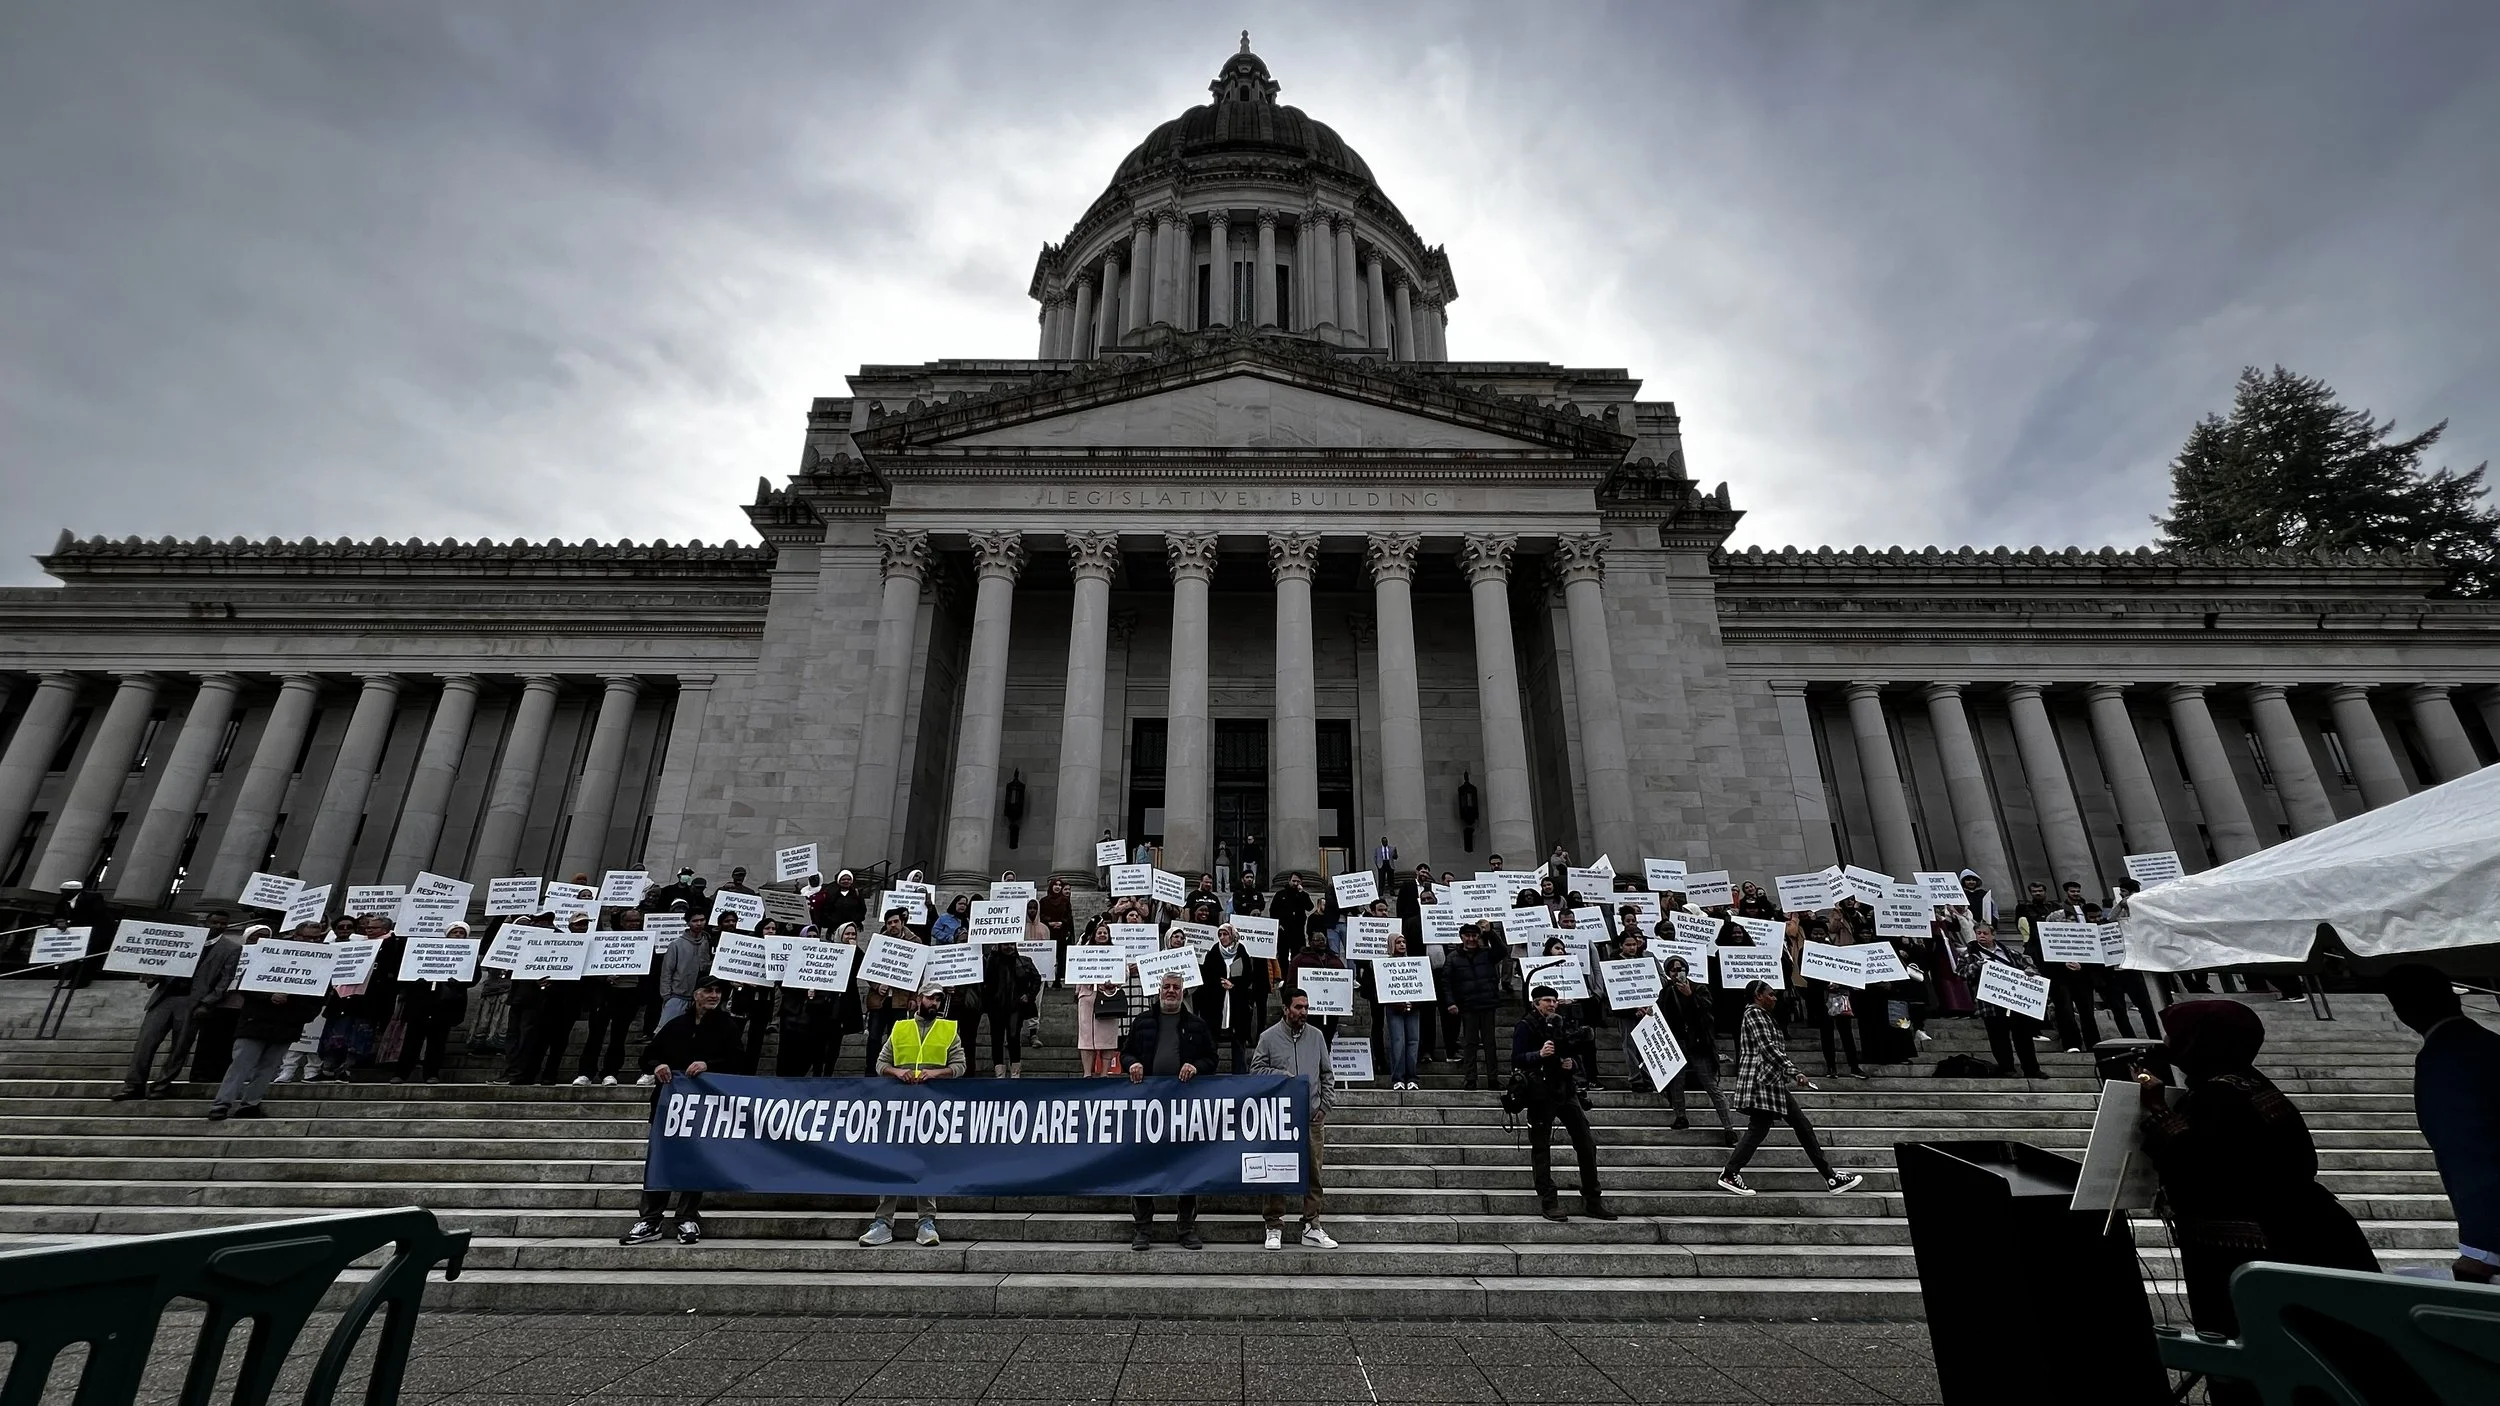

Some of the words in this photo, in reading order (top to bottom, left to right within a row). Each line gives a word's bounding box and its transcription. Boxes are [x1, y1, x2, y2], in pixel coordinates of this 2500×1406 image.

[1048, 490, 1248, 507] LEGISLATIVE
[1291, 490, 1440, 506] BUILDING
[726, 896, 758, 905] REFUGEES
[975, 917, 1009, 925] RESETTLE
[1690, 918, 1715, 927] CLASSES
[142, 928, 184, 938] ADDRESS
[989, 926, 1022, 935] POVERTY!
[1677, 923, 1714, 934] INCREASE
[1680, 932, 1710, 942] ECONOMIC
[144, 938, 194, 948] STUDENTS'
[114, 946, 177, 957] ACHIEVEMENT
[894, 944, 916, 953] YOURSELF
[282, 949, 332, 959] INTEGRATION
[898, 952, 914, 960] SHOES
[1140, 957, 1157, 965] DON'T
[1159, 952, 1182, 961] FORGET
[139, 958, 167, 966] NOW
[728, 958, 752, 966] OFFERED
[881, 958, 898, 966] WOULD
[269, 966, 300, 974] ABILITY
[866, 968, 889, 978] SPEAKING
[871, 962, 891, 971] SURVIVE
[890, 967, 913, 976] WITHOUT
[1838, 964, 1861, 974] VOTE!
[799, 975, 834, 983] FLOURISH!
[1989, 965, 2009, 975] MAKE
[2010, 972, 2043, 986] REFUGEE
[283, 977, 317, 985] ENGLISH
[1986, 971, 2018, 985] HOUSING
[2020, 982, 2044, 993] NEEDS
[1984, 984, 2011, 996] MENTAL
[2014, 993, 2041, 1006] HEALTH
[1998, 995, 2031, 1009] PRIORITY
[664, 1094, 700, 1138] BE
[700, 1095, 750, 1139] THE
[753, 1098, 830, 1142] VOICE
[828, 1099, 882, 1143] FOR
[886, 1100, 964, 1144] THOSE
[970, 1100, 1027, 1144] WHO
[1031, 1100, 1079, 1144] ARE
[1085, 1100, 1127, 1144] YET
[1132, 1098, 1164, 1143] TO
[1170, 1097, 1235, 1142] HAVE
[1241, 1097, 1299, 1141] ONE.
